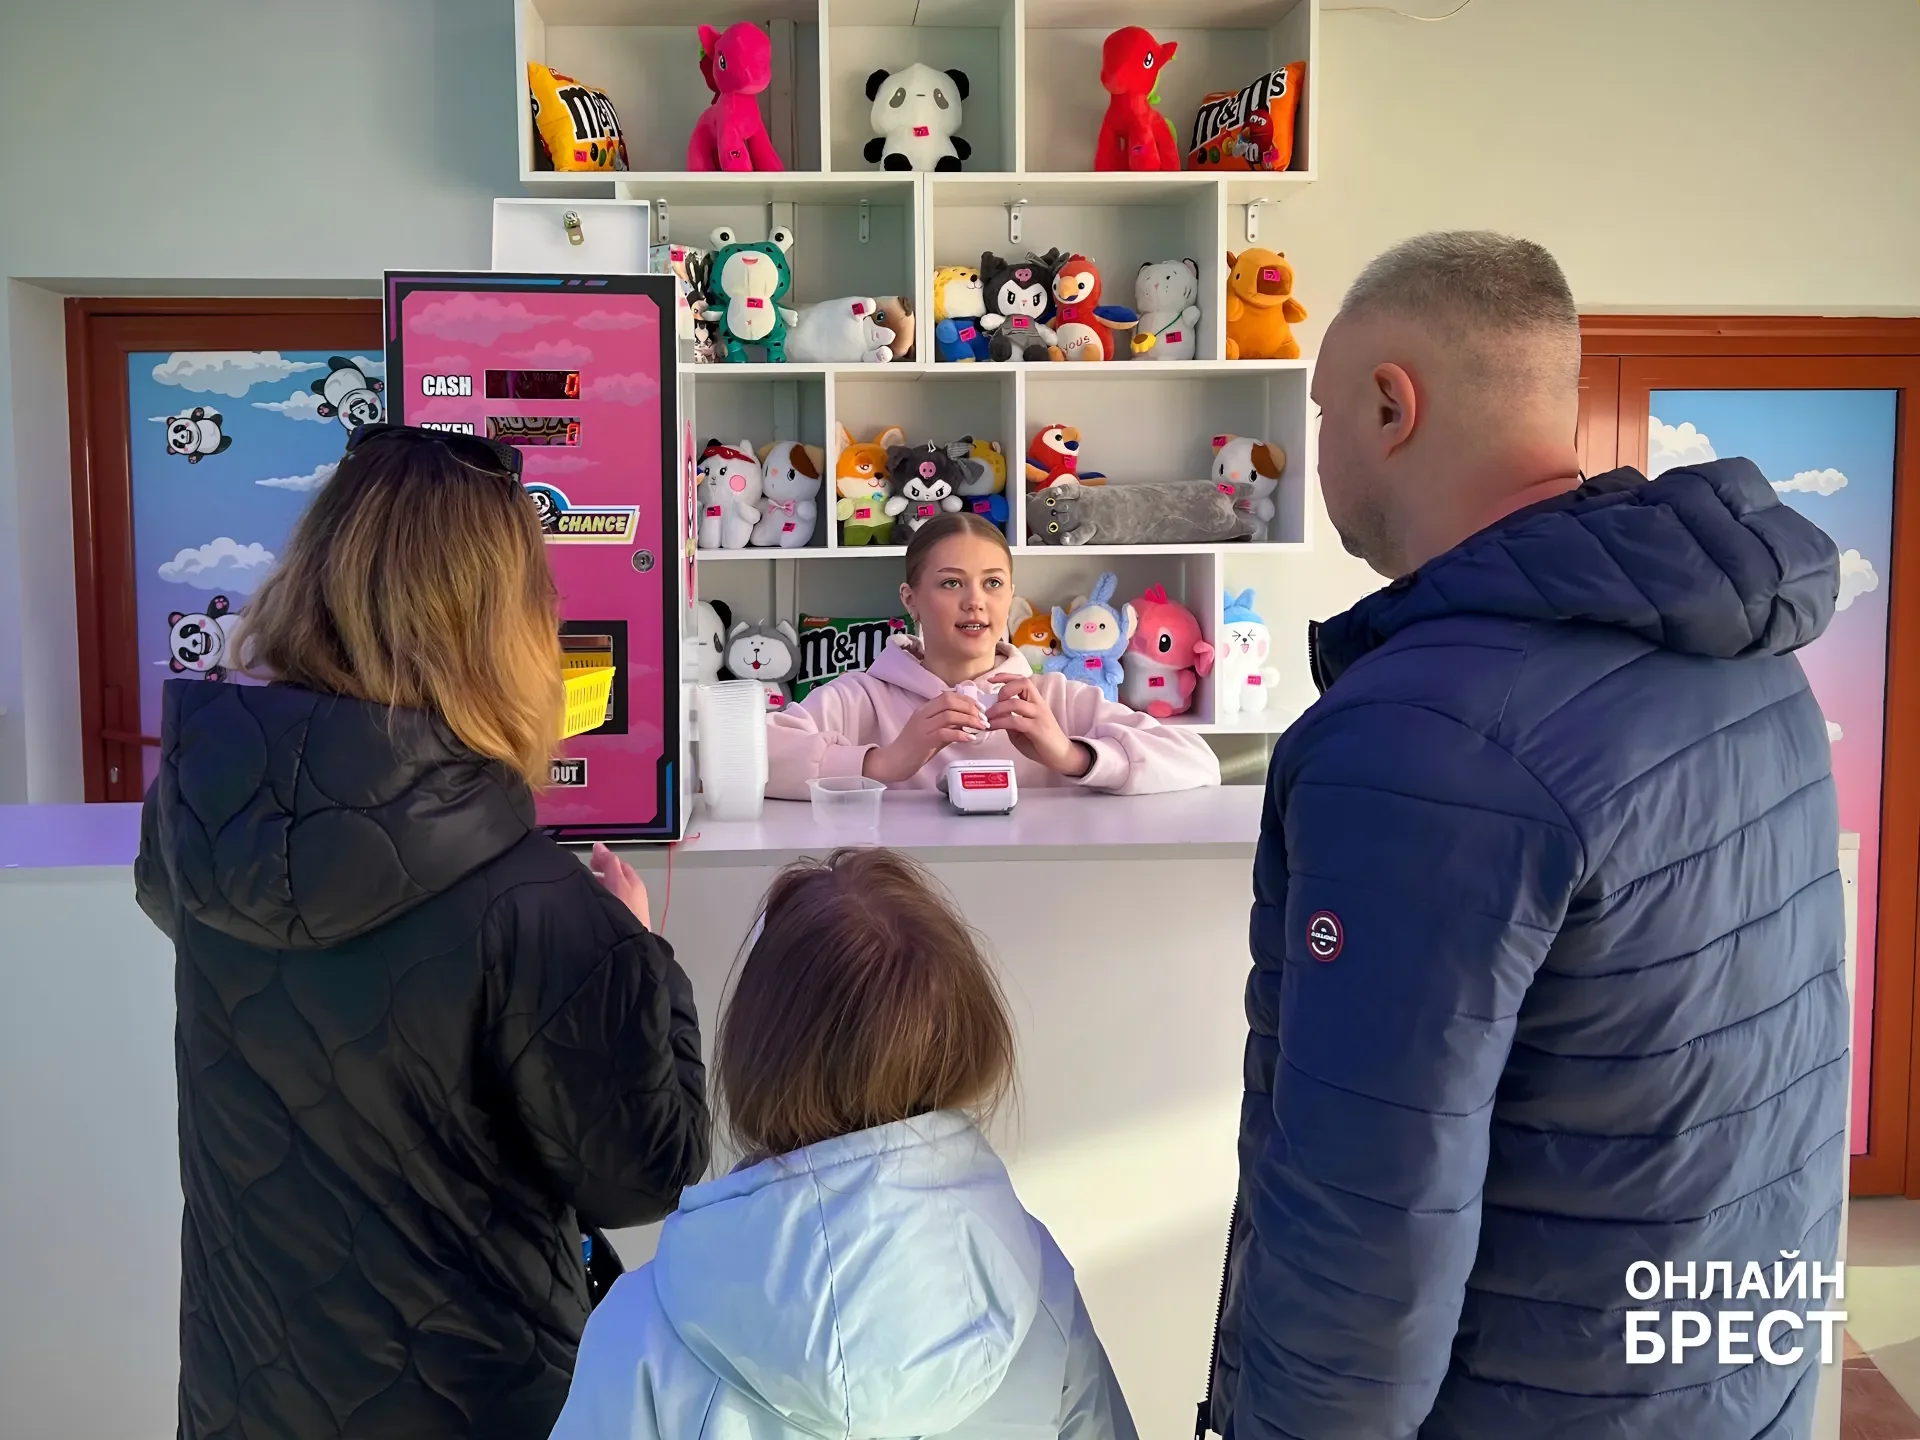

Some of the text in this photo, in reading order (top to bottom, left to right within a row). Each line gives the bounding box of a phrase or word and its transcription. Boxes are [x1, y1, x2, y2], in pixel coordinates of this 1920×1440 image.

[422, 375, 472, 396] CASH
[565, 373, 580, 397] 0
[558, 515, 627, 532] CHANCE
[551, 766, 578, 782] OUT
